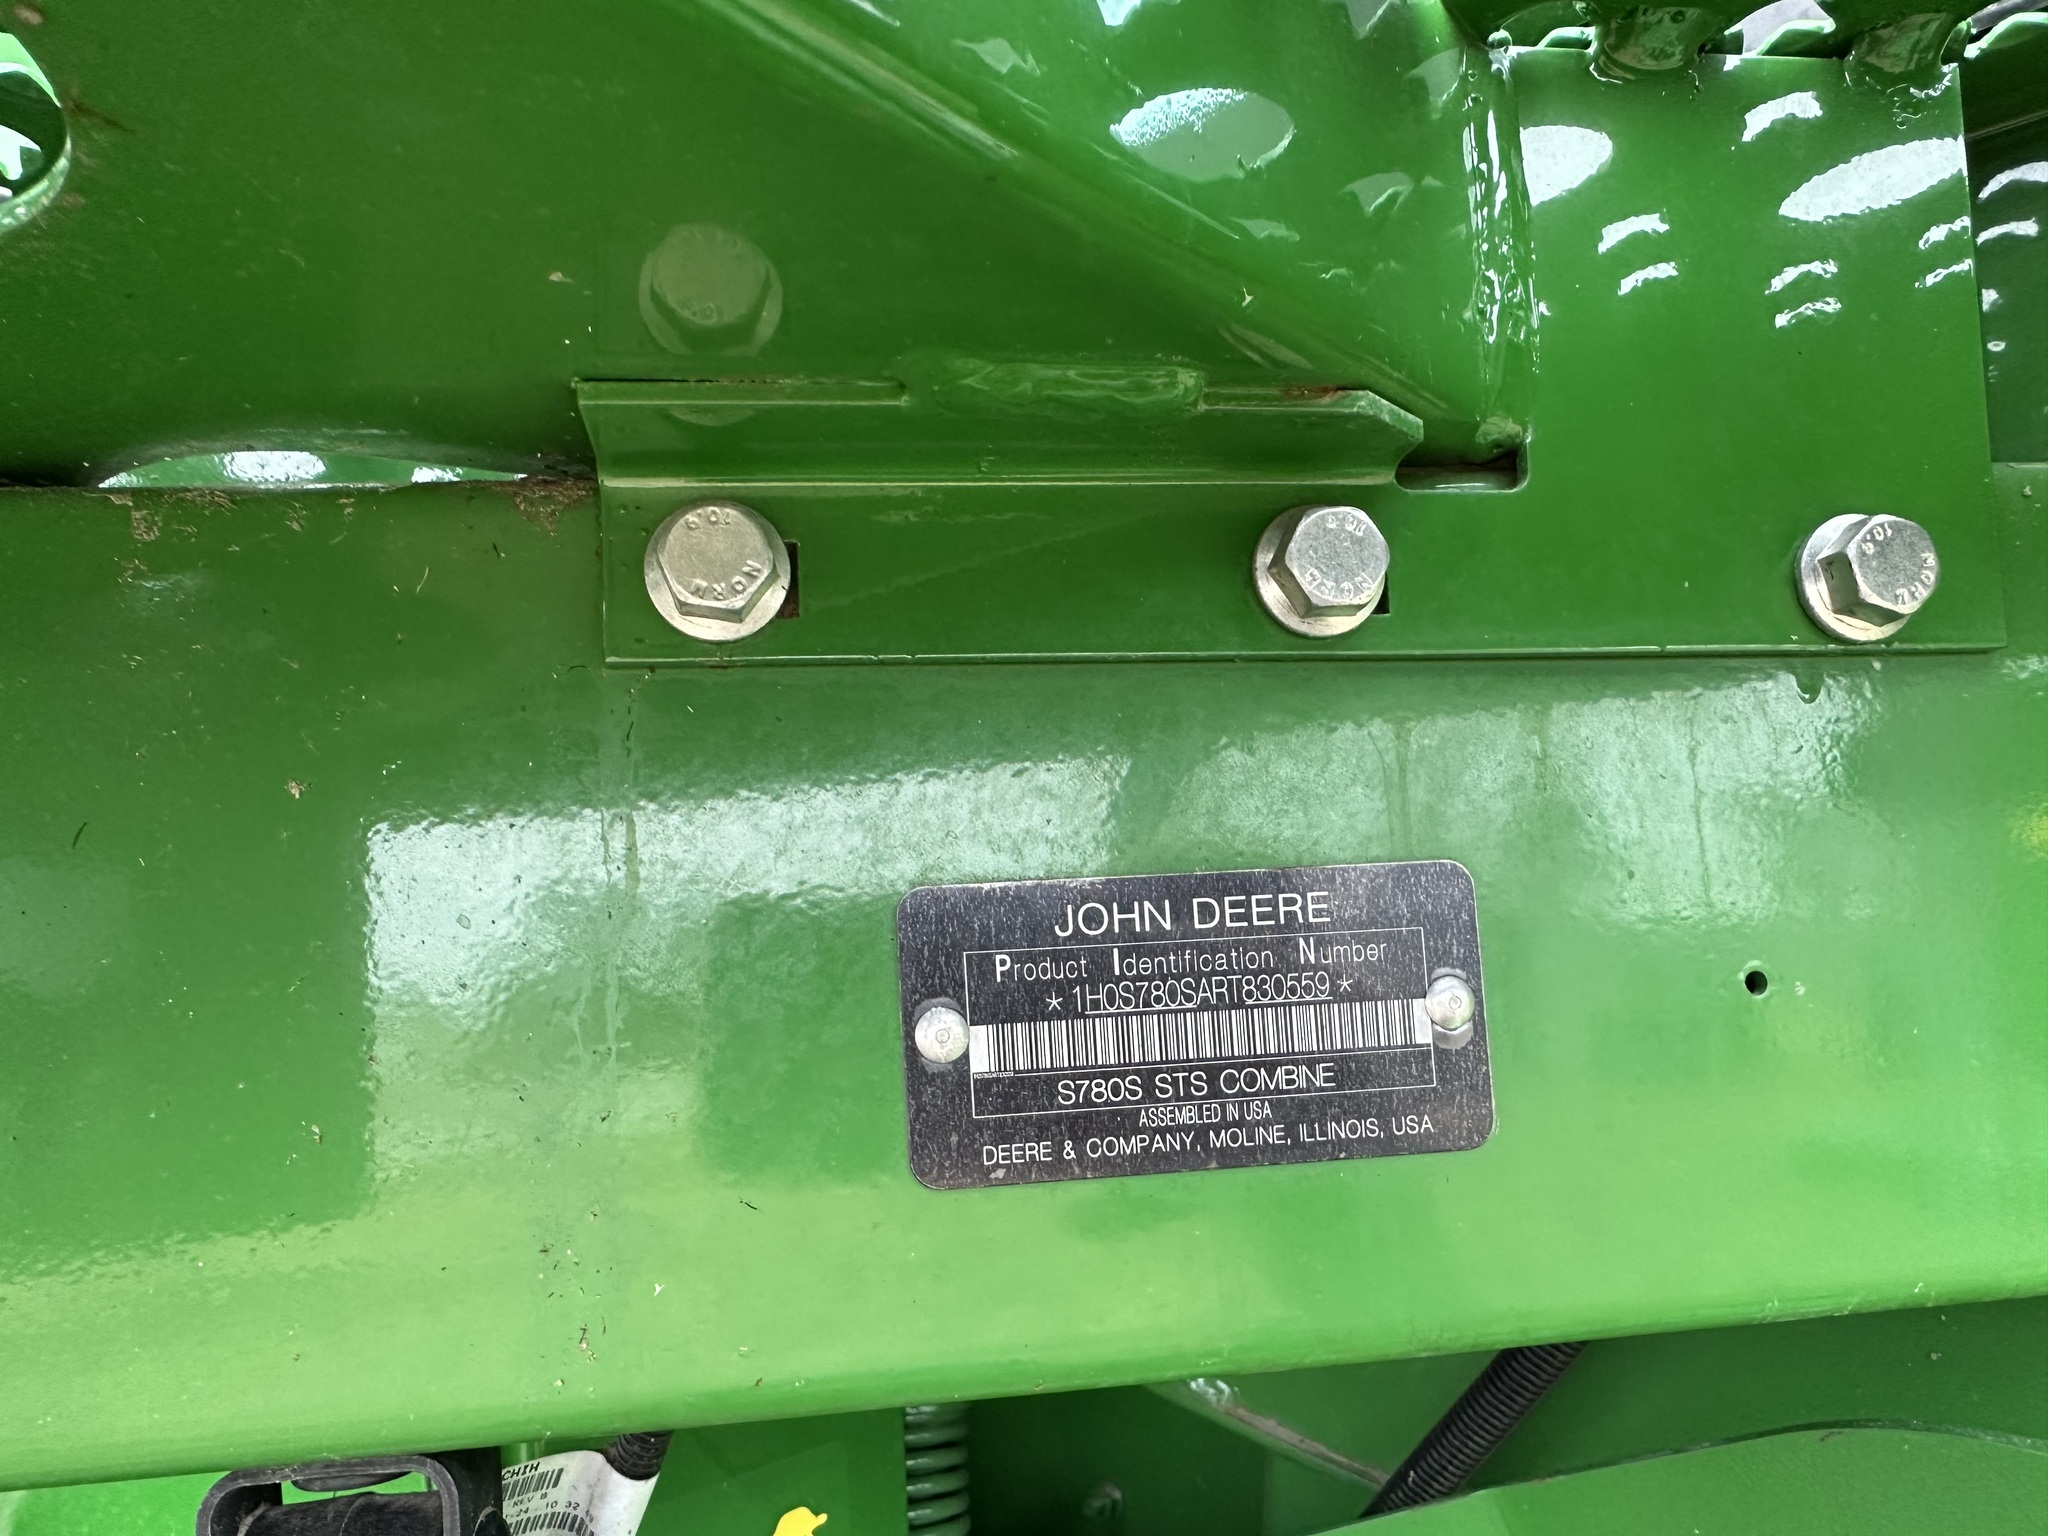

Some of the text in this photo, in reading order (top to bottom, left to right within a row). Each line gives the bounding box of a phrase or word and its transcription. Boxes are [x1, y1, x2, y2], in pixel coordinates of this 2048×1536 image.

[1054, 891, 1331, 937] JOHN DEERE
[995, 936, 1387, 983] Product Identification Number
[1057, 1062, 1336, 1105] S780S STS COMBINE
[1138, 1100, 1273, 1128] ASSEMBLED IN USA
[983, 1114, 1435, 1166] DEERE & COMPANY, MOLINE, ILLINOIS, USA
